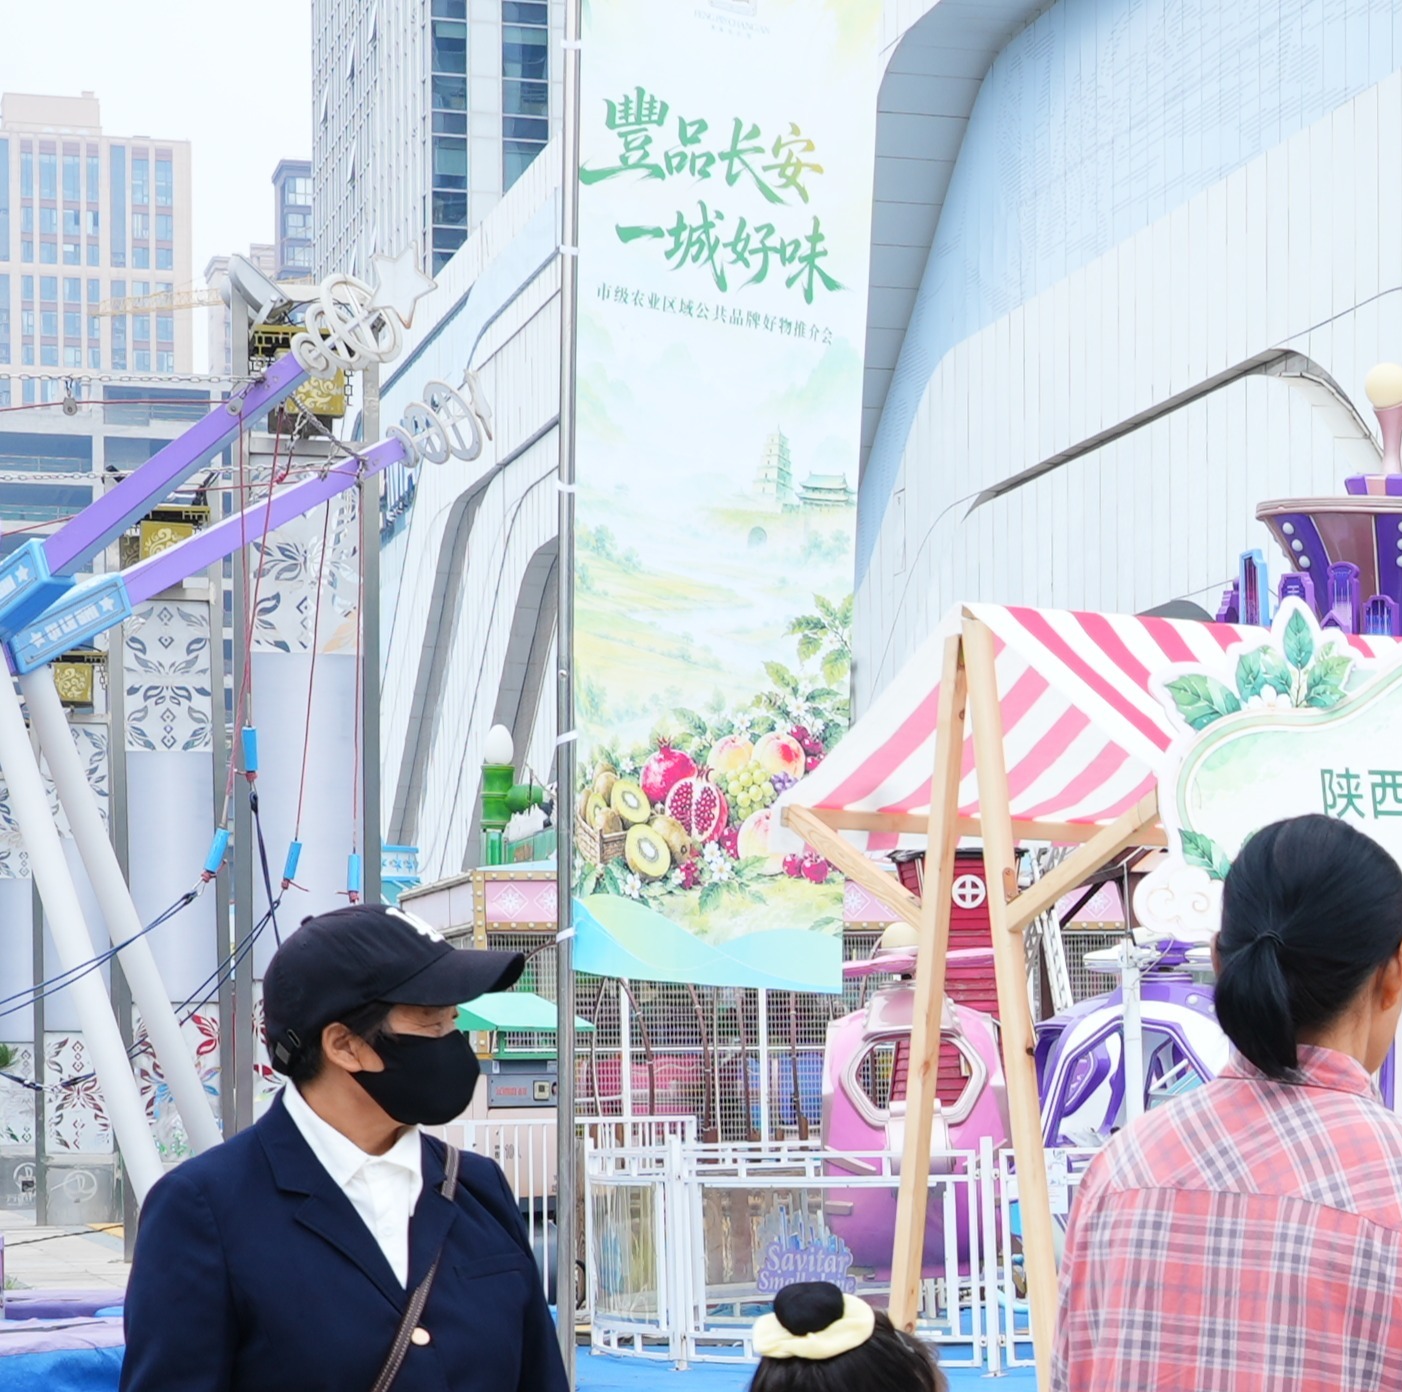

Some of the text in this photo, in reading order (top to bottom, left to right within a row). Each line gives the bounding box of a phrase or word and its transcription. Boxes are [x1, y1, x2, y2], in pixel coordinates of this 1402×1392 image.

[615, 201, 848, 305] 一城好味
[596, 283, 834, 346] 市级农业区域公共品牌好物推介会
[767, 1244, 852, 1272] Savitar
